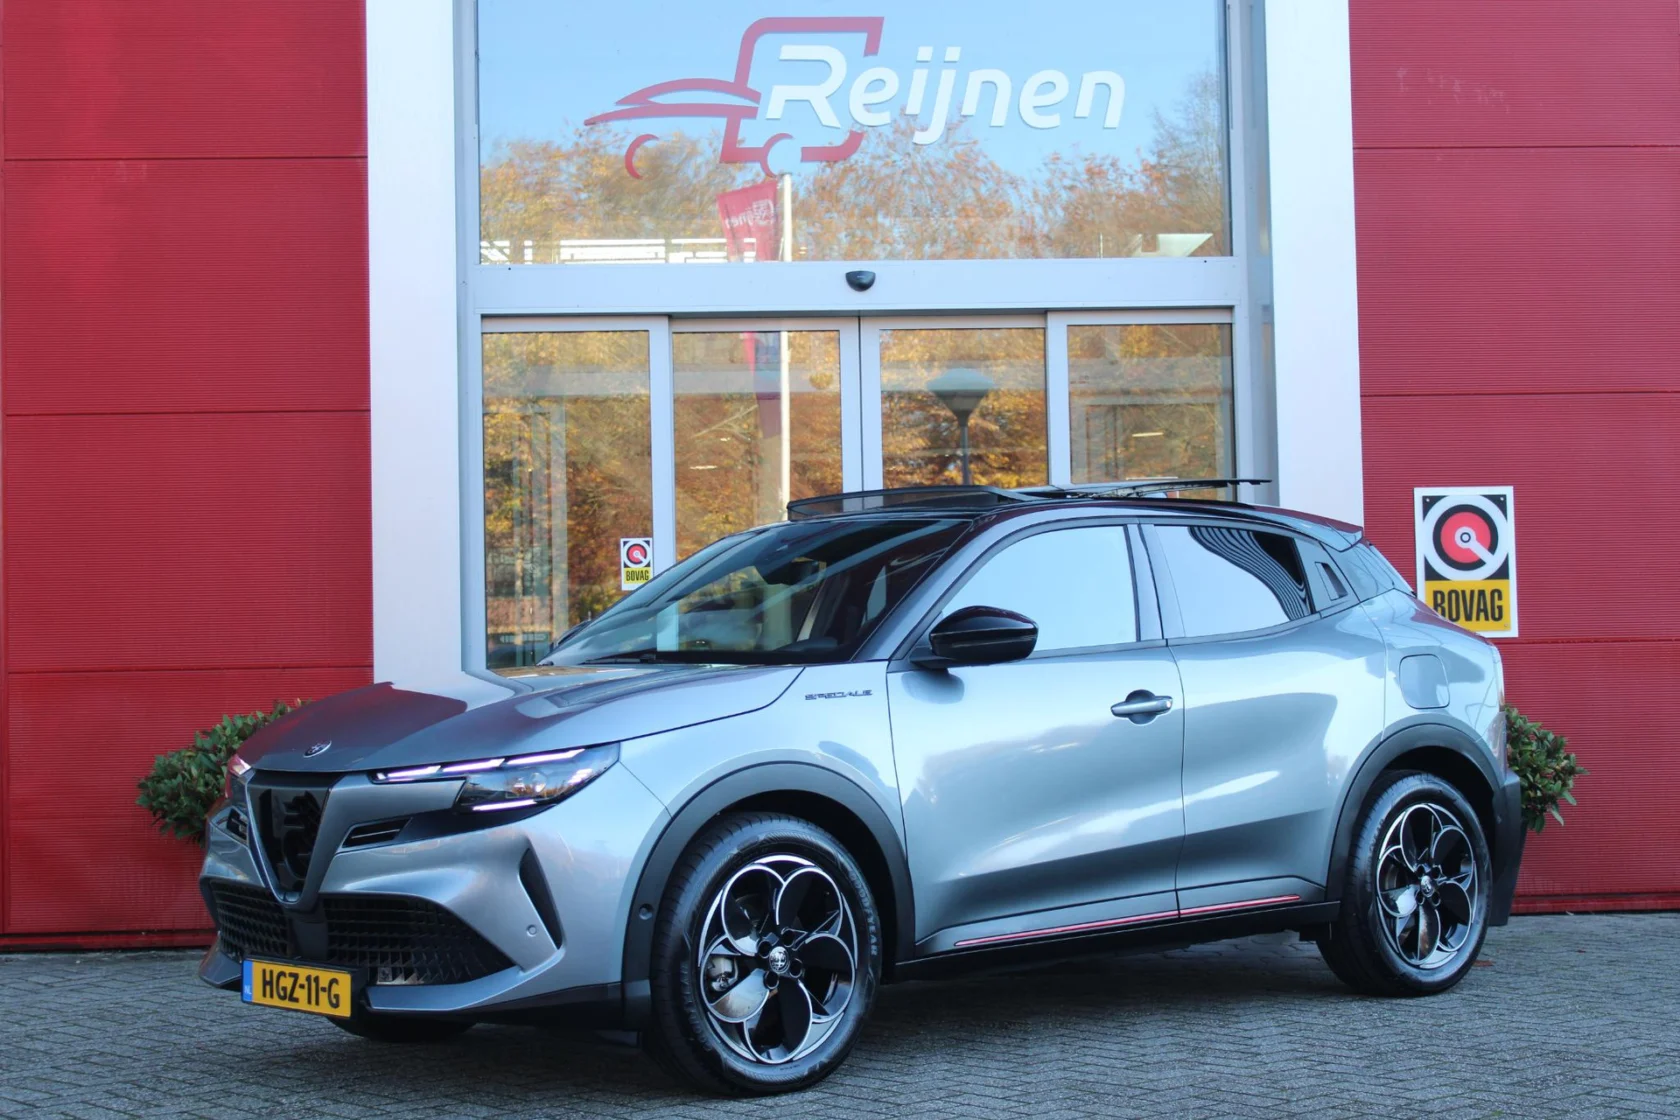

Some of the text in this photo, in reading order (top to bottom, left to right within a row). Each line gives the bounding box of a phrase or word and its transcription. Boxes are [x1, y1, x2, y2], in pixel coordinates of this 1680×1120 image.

[765, 45, 1126, 144] Reijnen
[626, 570, 650, 581] BOVAG
[1432, 588, 1503, 622] BOVAG
[244, 985, 252, 995] NL
[262, 968, 340, 1009] HGZ-11-G
